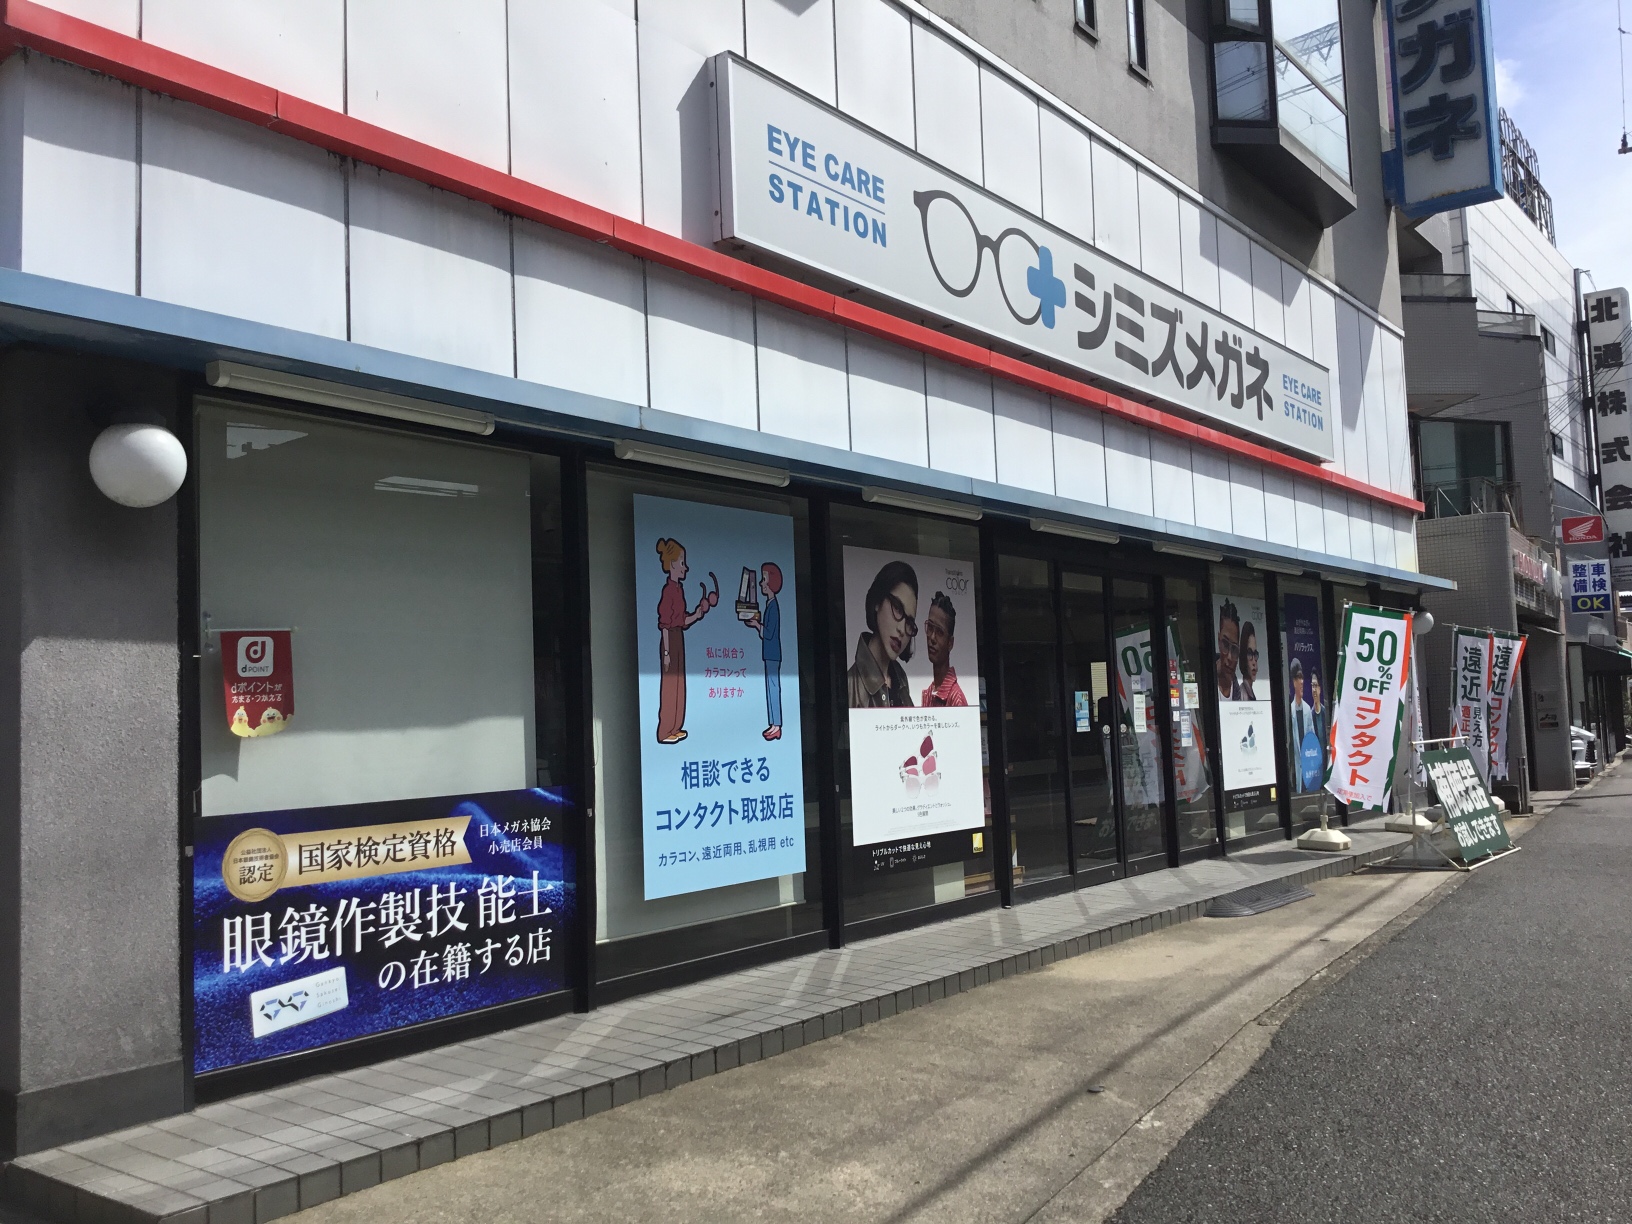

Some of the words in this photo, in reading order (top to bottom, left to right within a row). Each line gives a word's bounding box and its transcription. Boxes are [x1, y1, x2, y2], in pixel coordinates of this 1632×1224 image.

[1395, 0, 1482, 161] ガネ
[767, 123, 817, 172] EYE
[824, 153, 885, 204] CARE
[768, 173, 887, 248] STATION
[1074, 262, 1274, 421] シミズメガネ
[1282, 374, 1299, 396] EYE
[1301, 383, 1322, 406] CARE
[1284, 400, 1324, 431] STATION
[1572, 564, 1588, 593] 整備
[1591, 563, 1607, 592] 車検
[1577, 597, 1605, 610] OK
[706, 647, 745, 659] 私に似合う
[1356, 626, 1398, 666] 50
[231, 681, 283, 694] dポイントが
[705, 667, 747, 678] カラコンって
[1353, 676, 1391, 695] OFF
[709, 687, 744, 698] ありますか
[1348, 696, 1382, 786] コンタクト
[681, 757, 770, 790] 相談できる
[480, 816, 552, 838] 日本メガネ協会
[656, 792, 794, 831] コンタクト取扱店
[298, 829, 457, 875] 国家検定資格
[488, 835, 543, 855] 小売店会員
[780, 836, 794, 848] etc
[239, 863, 274, 885] 認定
[223, 870, 554, 974] 眼鏡作製技能士
[378, 927, 553, 991] の在籍する店
